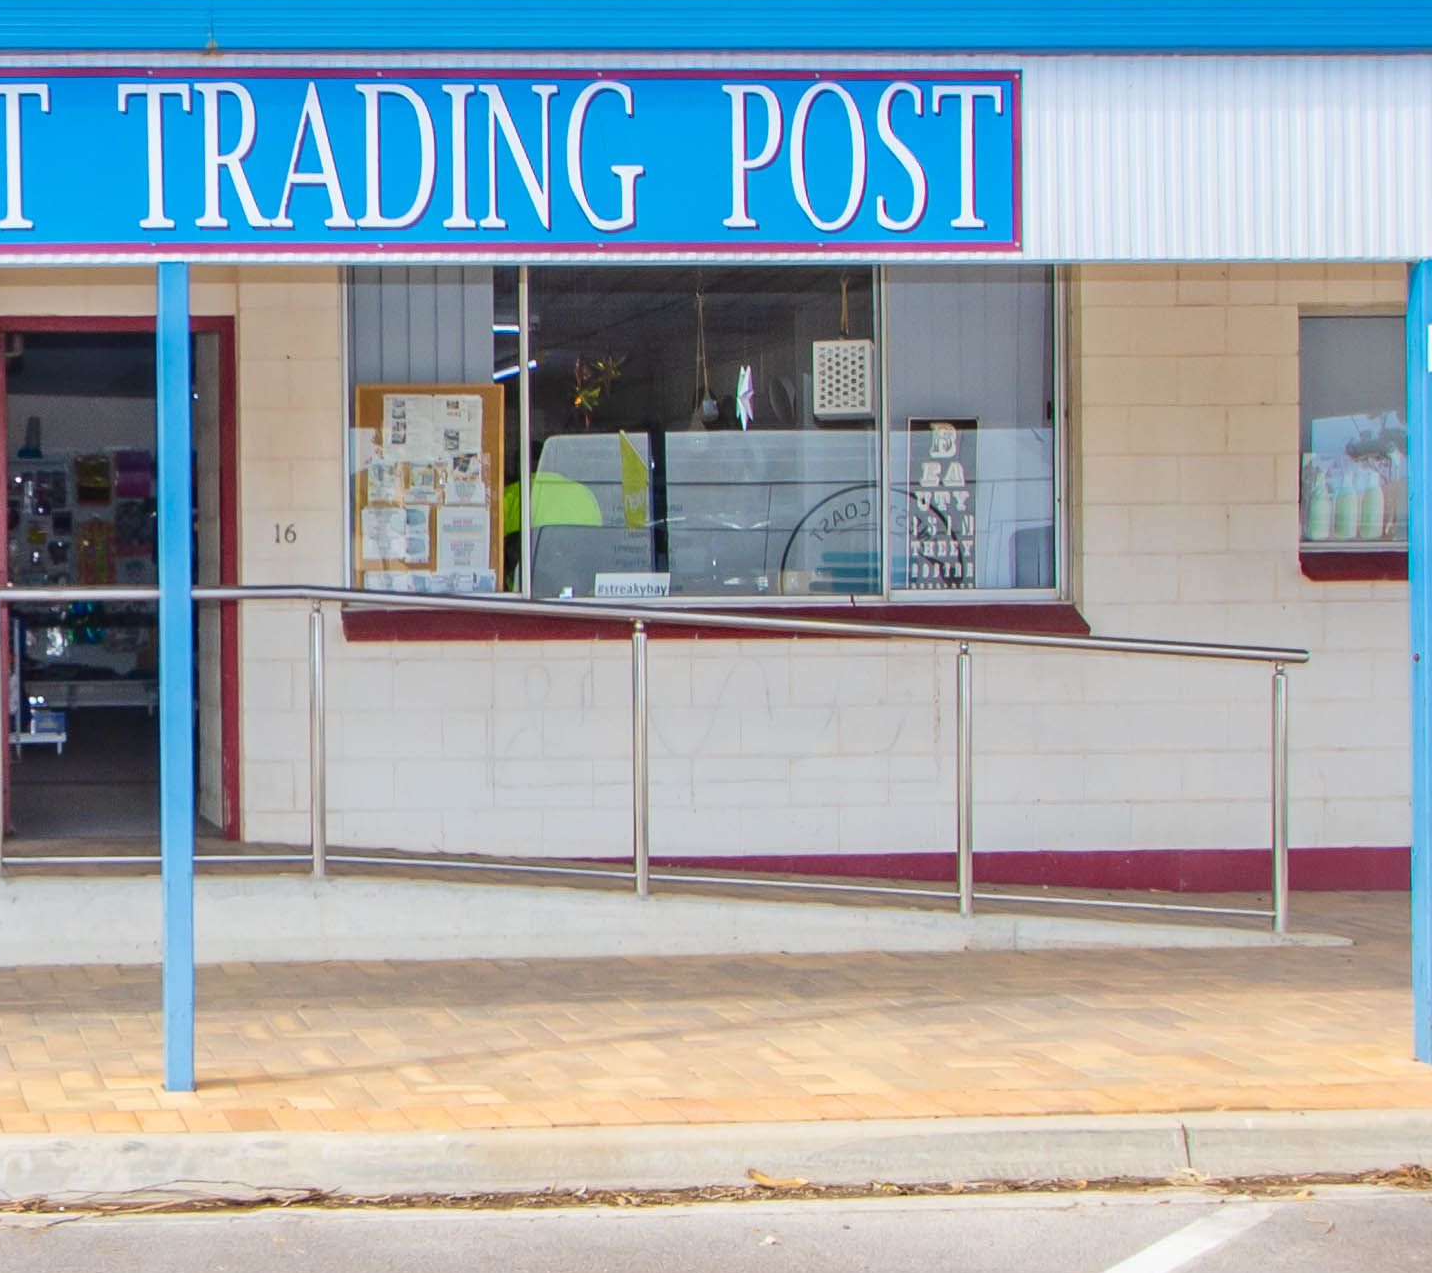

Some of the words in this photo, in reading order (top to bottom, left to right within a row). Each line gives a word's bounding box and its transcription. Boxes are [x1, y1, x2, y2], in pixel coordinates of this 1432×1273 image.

[116, 80, 644, 235] TRADING
[720, 80, 1005, 234] POST
[915, 491, 970, 511] UTY
[274, 523, 296, 543] 16
[598, 578, 667, 596] #streakybay
